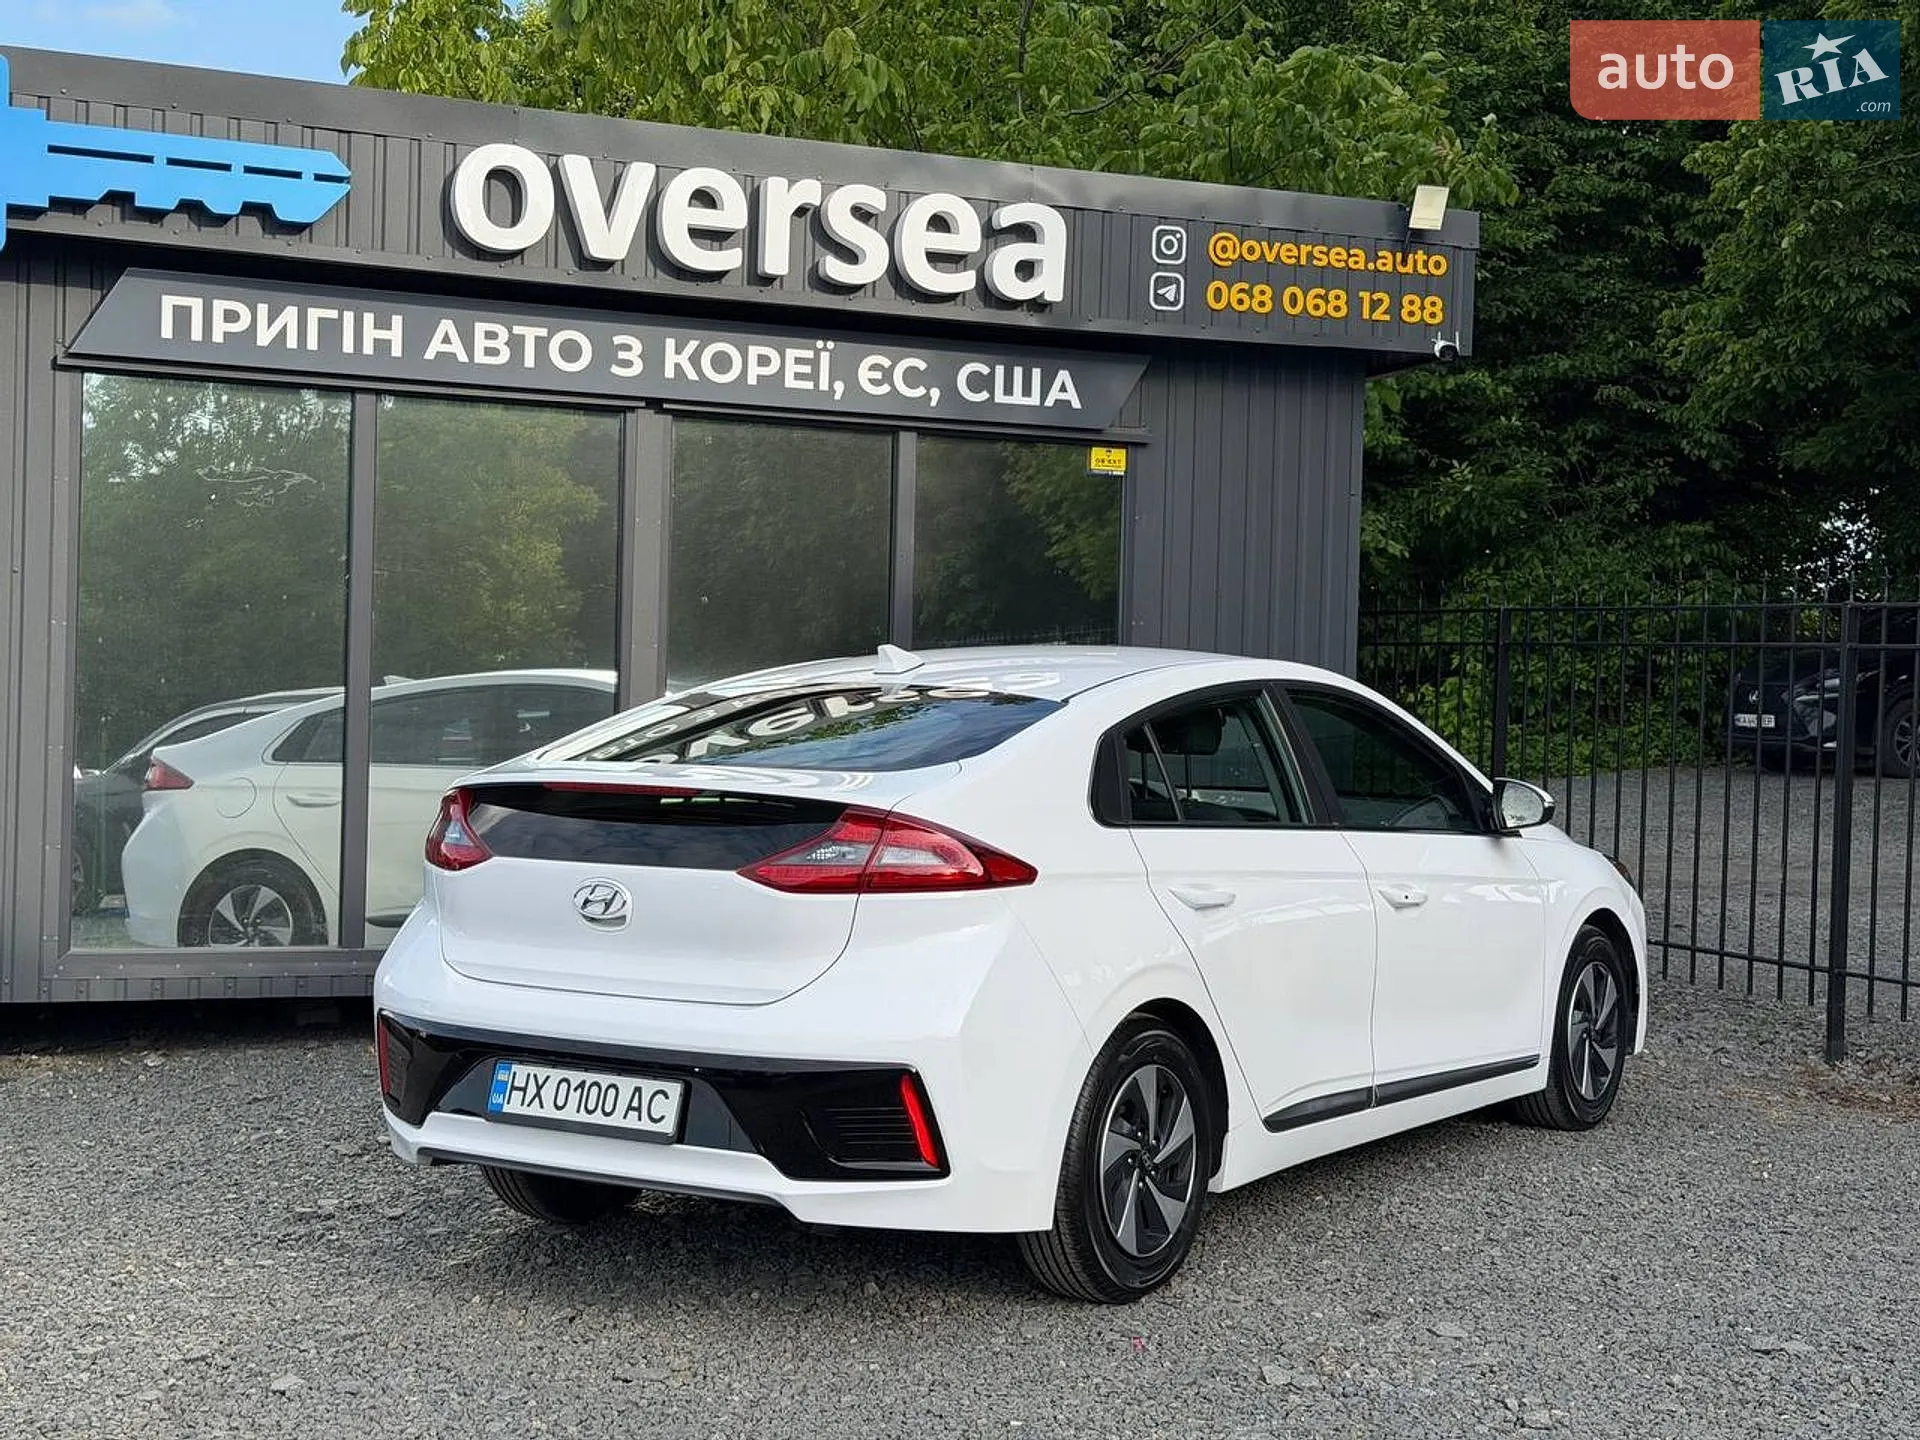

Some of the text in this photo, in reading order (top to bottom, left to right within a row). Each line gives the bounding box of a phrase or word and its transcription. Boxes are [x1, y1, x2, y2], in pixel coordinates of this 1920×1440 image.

[450, 142, 1068, 303] oversea
[1208, 232, 1448, 276] @oversea.auto
[1206, 280, 1444, 324] 068 068 12 88
[160, 294, 1082, 410] ПРИГІН АВТО З КОРЕЇ, ЄС, США
[507, 1071, 670, 1124] HX 0100 AC
